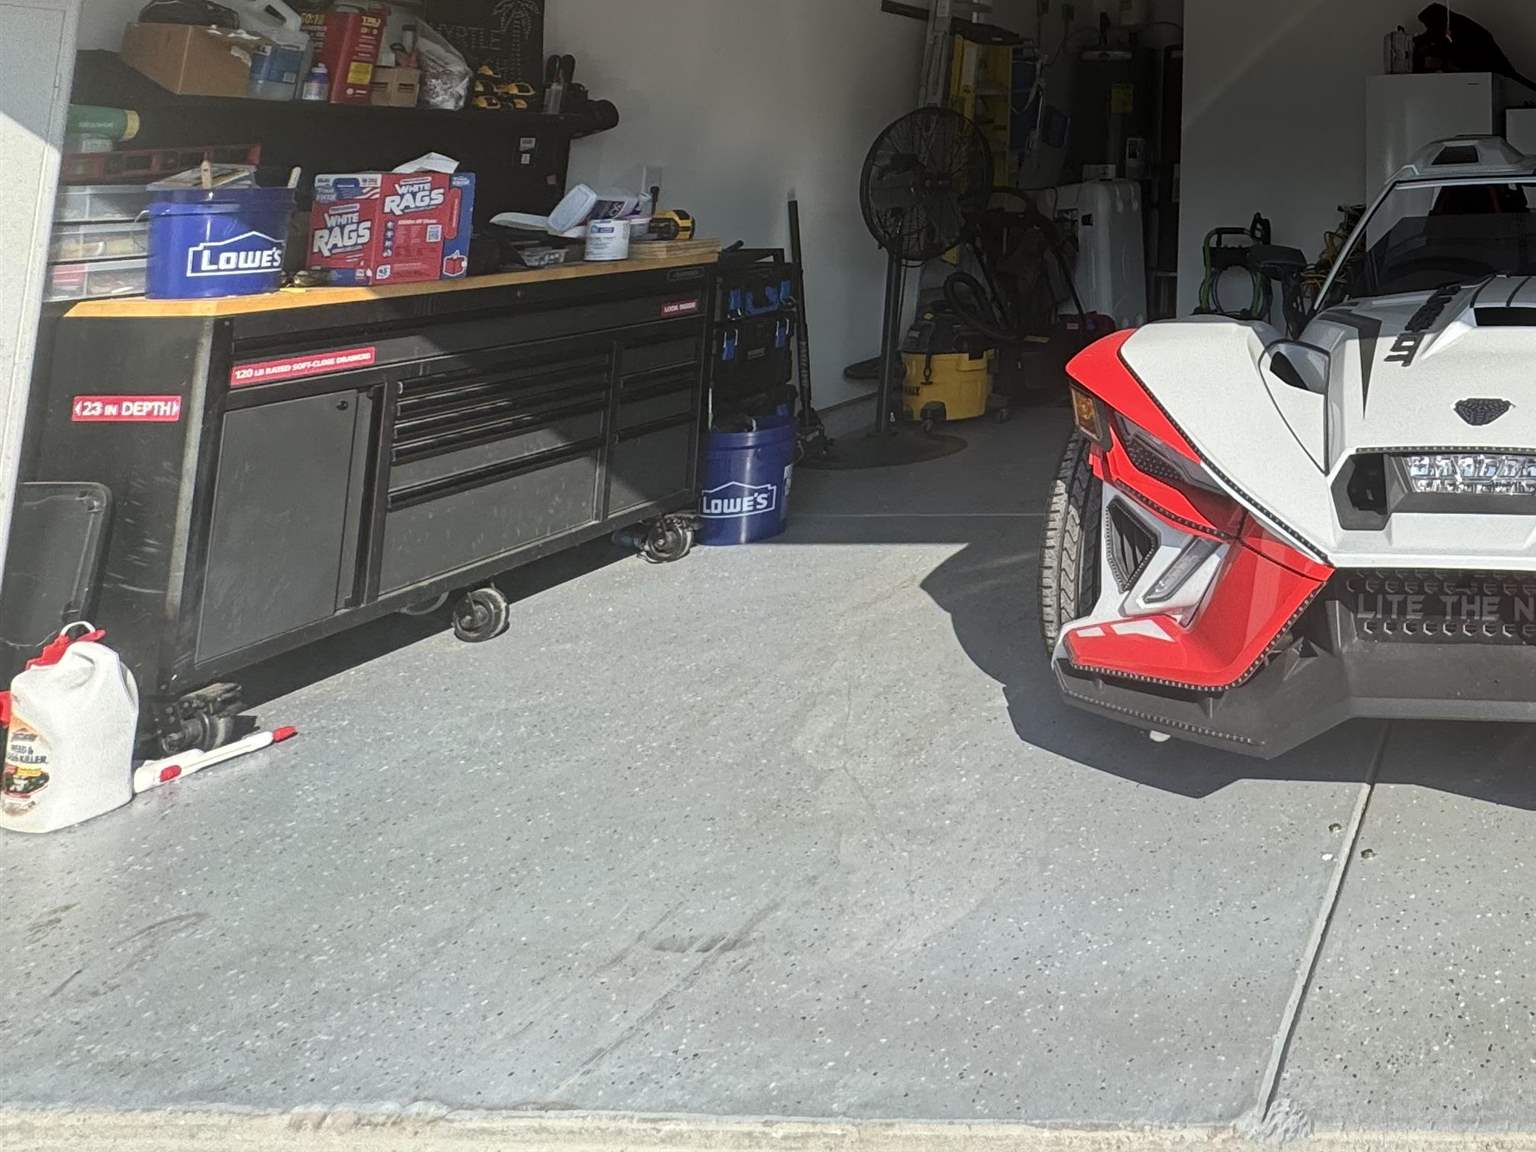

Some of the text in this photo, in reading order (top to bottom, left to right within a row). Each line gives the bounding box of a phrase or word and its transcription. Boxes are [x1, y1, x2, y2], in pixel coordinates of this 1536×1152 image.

[395, 182, 432, 195] WHITE
[384, 188, 445, 216] RAGS
[324, 213, 360, 228] WHITE
[313, 221, 372, 257] RAGS
[201, 247, 282, 271] LOWE'S
[235, 369, 254, 380] 120
[82, 401, 171, 416] 23 IN DEPTH
[702, 492, 768, 514] LOWE'S
[1357, 593, 1425, 619] LITE
[1439, 595, 1500, 620] THE
